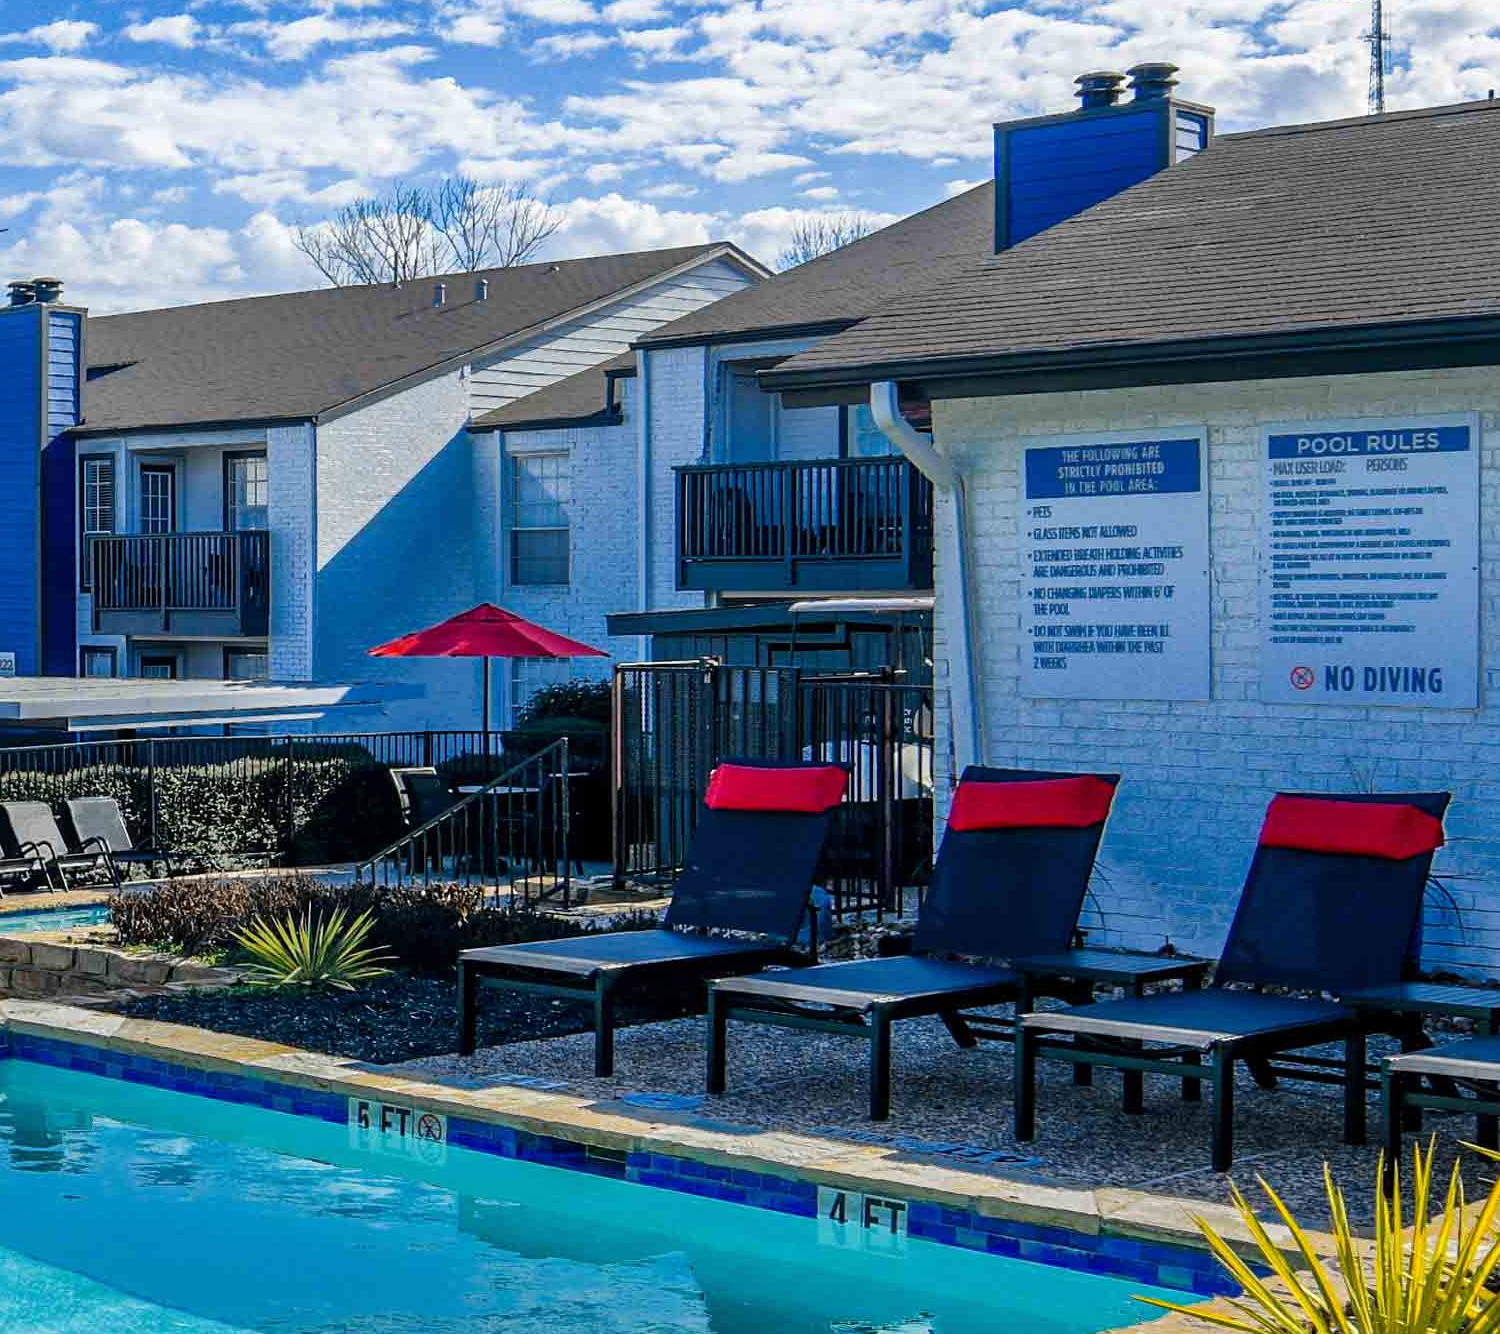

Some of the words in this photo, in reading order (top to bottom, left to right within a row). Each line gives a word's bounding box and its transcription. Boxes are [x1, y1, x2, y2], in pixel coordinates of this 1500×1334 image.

[1297, 436, 1359, 455] POOL
[1367, 433, 1440, 451] RULES
[1062, 450, 1079, 462] THE
[1082, 447, 1138, 462] FOLLOWING
[1142, 445, 1160, 459] ARE
[1057, 466, 1101, 479] STRICTLY
[1104, 461, 1164, 476] PROHIBITED
[1273, 461, 1294, 475] MAX
[1366, 458, 1408, 472] PERSONS
[1065, 482, 1075, 494] IN
[1079, 481, 1096, 493] THE
[1100, 480, 1124, 492] POOL
[1033, 506, 1052, 518] PETS
[1033, 527, 1057, 539] GLASS
[1082, 526, 1098, 538] NOT
[1099, 525, 1137, 537] ALLOWED
[1033, 549, 1072, 562] EXTENDED
[1143, 547, 1183, 559] ACTIVITIES
[1033, 566, 1048, 577] ARE
[1050, 565, 1096, 577] DANGEROUS
[1098, 564, 1116, 576] AND
[1118, 563, 1164, 575] PROHIBITED
[1033, 587, 1046, 599] NO
[1033, 604, 1048, 615] THE
[1049, 603, 1069, 615] POOL
[1034, 626, 1046, 637] DO
[1033, 658, 1039, 669] 2
[1040, 657, 1066, 669] WEEKS
[1325, 665, 1355, 691] NO
[1363, 666, 1442, 693] DIVING
[359, 1101, 369, 1128] 5
[382, 1106, 410, 1136] FT
[830, 1193, 848, 1224] 4
[865, 1198, 906, 1234] FT
